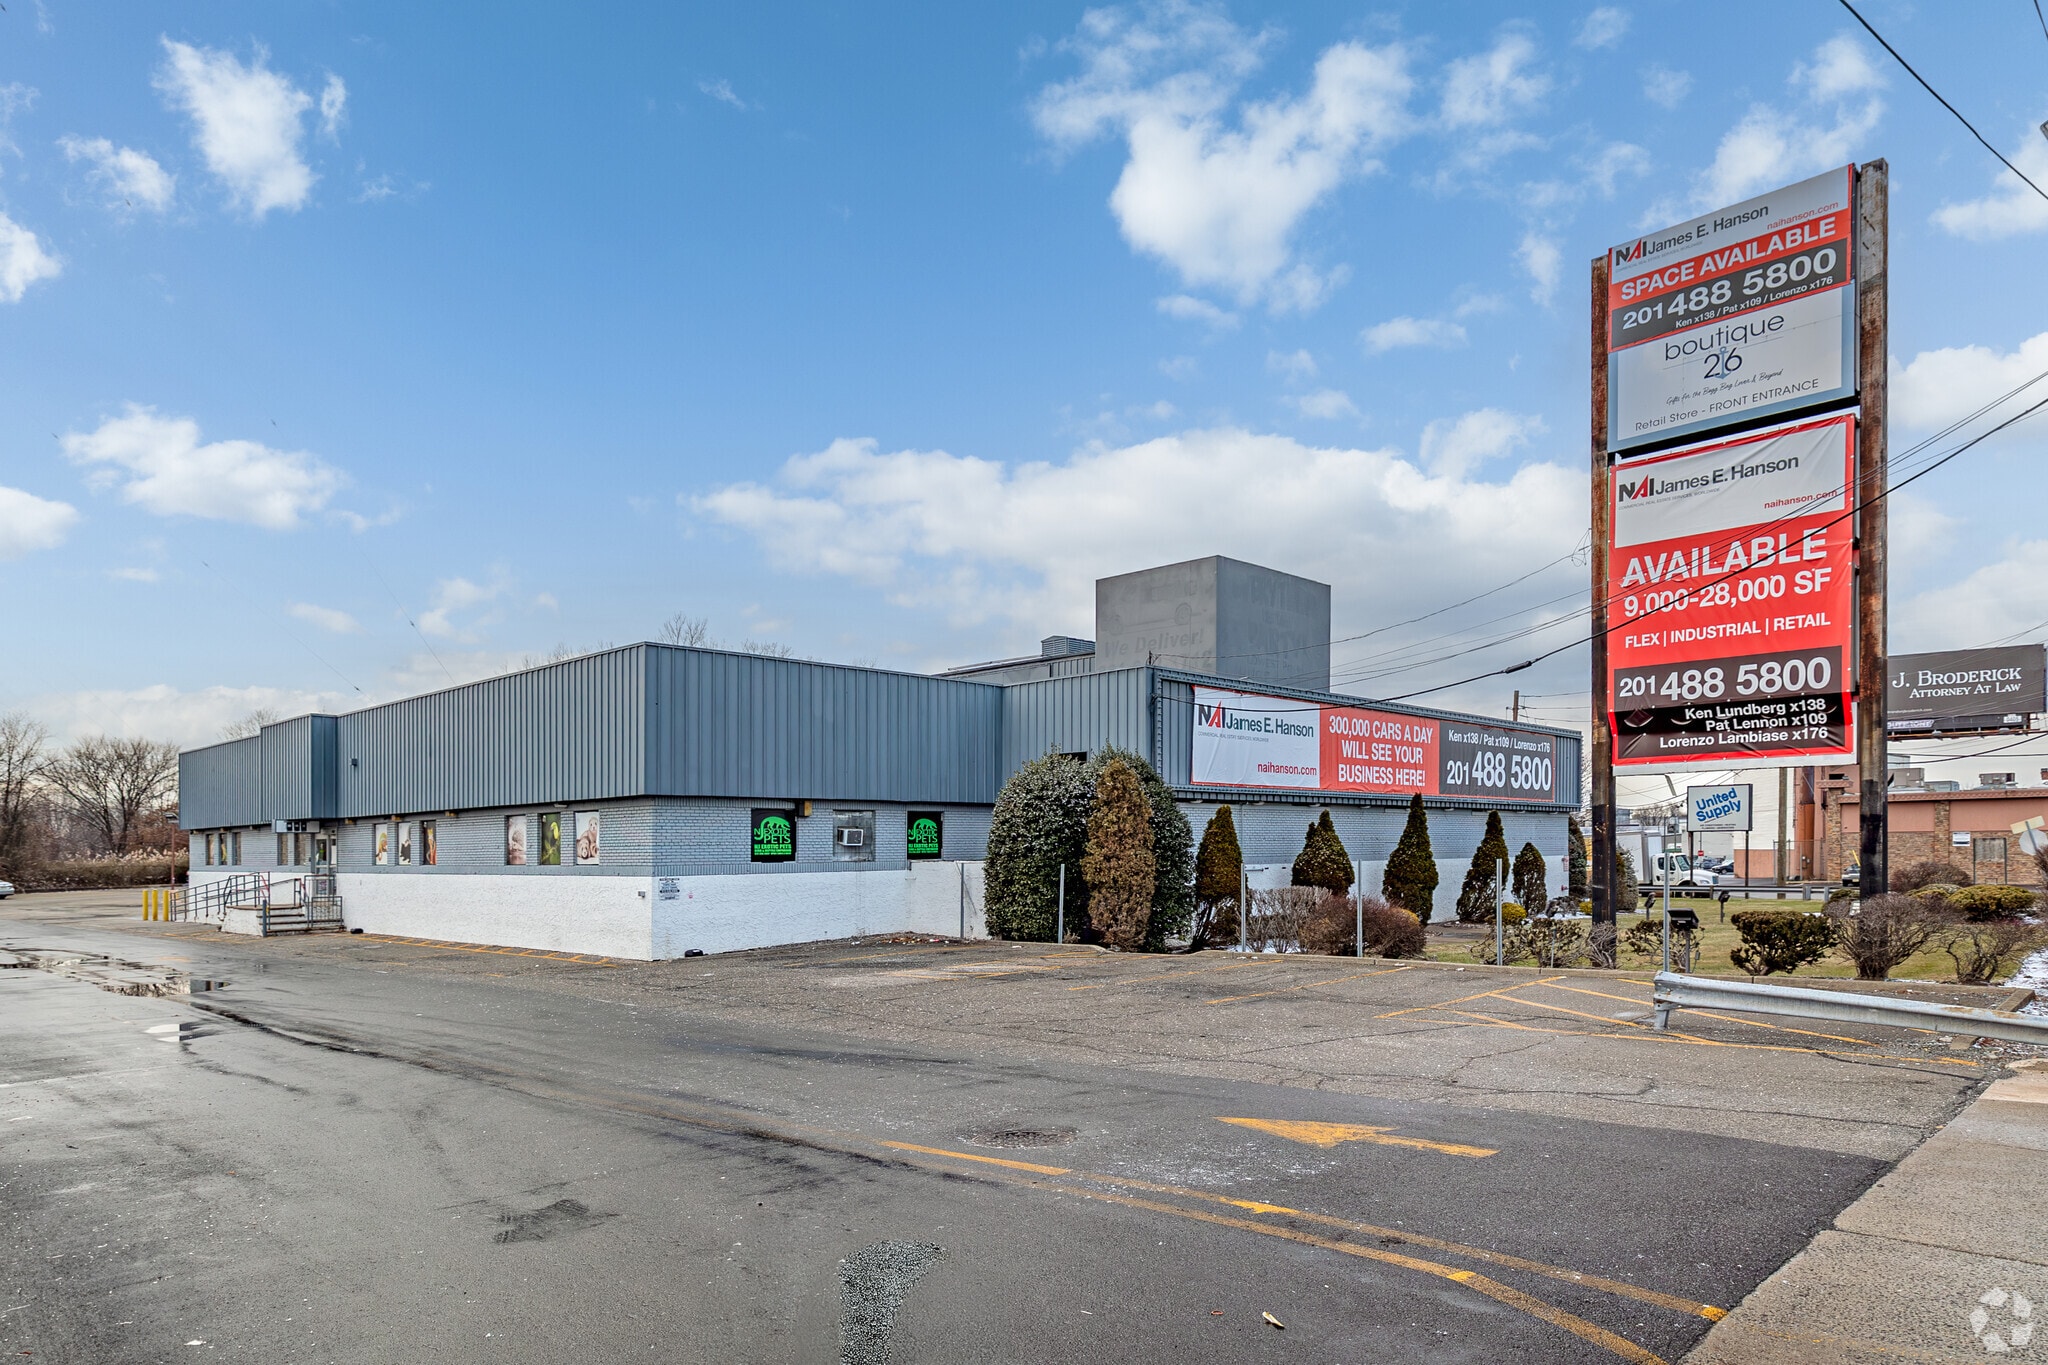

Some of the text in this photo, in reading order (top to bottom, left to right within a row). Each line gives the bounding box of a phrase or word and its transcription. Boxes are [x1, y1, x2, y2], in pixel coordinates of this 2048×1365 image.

[1767, 202, 1839, 230] naihanson.com
[1615, 205, 1769, 266] NAI James E. Hanson
[1621, 216, 1836, 301] SPACE AVAILABLE
[1622, 248, 1837, 330] 201 488 5800
[1675, 316, 1693, 329] Ken
[1694, 310, 1715, 325] x138
[1722, 302, 1738, 314] Pat
[1740, 297, 1762, 311] x109
[1770, 284, 1808, 302] Lorenzo
[1809, 276, 1834, 291] x176
[1665, 315, 1785, 361] boutique
[1703, 347, 1743, 379] 26
[1635, 416, 1666, 432] Retail
[1669, 408, 1698, 424] Store
[1709, 396, 1748, 413] FRONT
[1752, 378, 1820, 403] ENTRANCE
[1618, 456, 1800, 503] NAI James E. Hanson
[1764, 489, 1838, 511] naihanson.com
[1620, 527, 1828, 589] AVAILABLE
[1623, 567, 1832, 618] 9,000-28,000 SF
[1625, 631, 1660, 649] FLEX
[1670, 618, 1761, 643] INDUSTRIAL
[1773, 612, 1831, 632] RETAIL
[1619, 656, 1833, 701] 201 488 5800
[1891, 671, 1910, 688] J.
[1198, 701, 1314, 738] NAI James E. Hanson
[1684, 698, 1826, 721] Ken Lundberg x138
[1705, 713, 1828, 733] Pat Lennon x109
[1329, 715, 1433, 744] 300,000 CARS A DAY
[1448, 730, 1463, 742] Ken
[1463, 733, 1478, 745] x138
[1484, 734, 1495, 746] Pat
[1495, 736, 1510, 748] x109
[1514, 738, 1537, 751] Lorenzo
[1537, 741, 1551, 753] x176
[1660, 726, 1828, 749] Lorenzo Lambiase x176
[1341, 739, 1423, 765] WILL SEE YOUR
[1257, 762, 1317, 776] naihanson.com
[1338, 763, 1426, 787] BUSINESS HERE!
[1446, 750, 1552, 791] 201 488 5800
[1695, 787, 1738, 810] United
[1695, 800, 1741, 822] Supply
[763, 835, 791, 844] PETS
[916, 835, 938, 843] PETS
